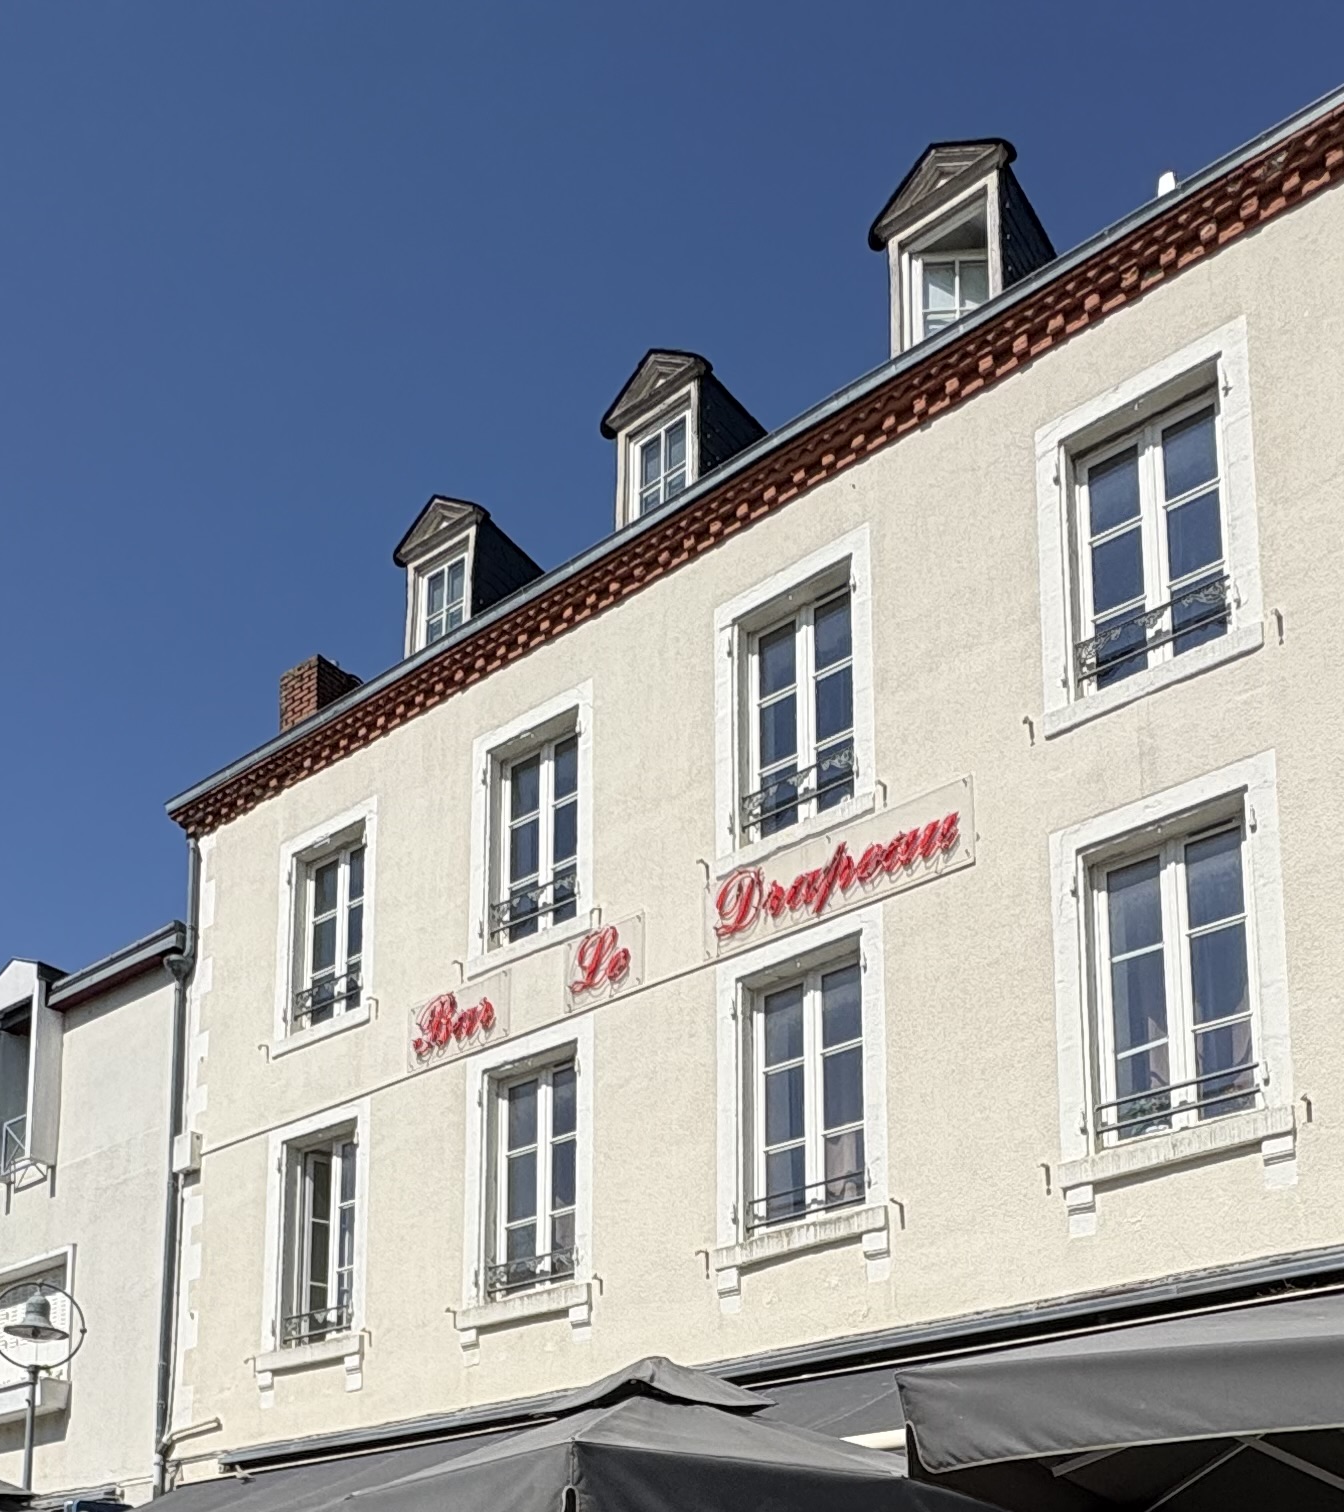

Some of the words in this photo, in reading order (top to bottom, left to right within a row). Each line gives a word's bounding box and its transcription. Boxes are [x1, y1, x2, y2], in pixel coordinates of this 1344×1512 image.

[413, 991, 495, 1056] Bar
[569, 925, 632, 995] Le
[714, 811, 960, 938] Drapeau
